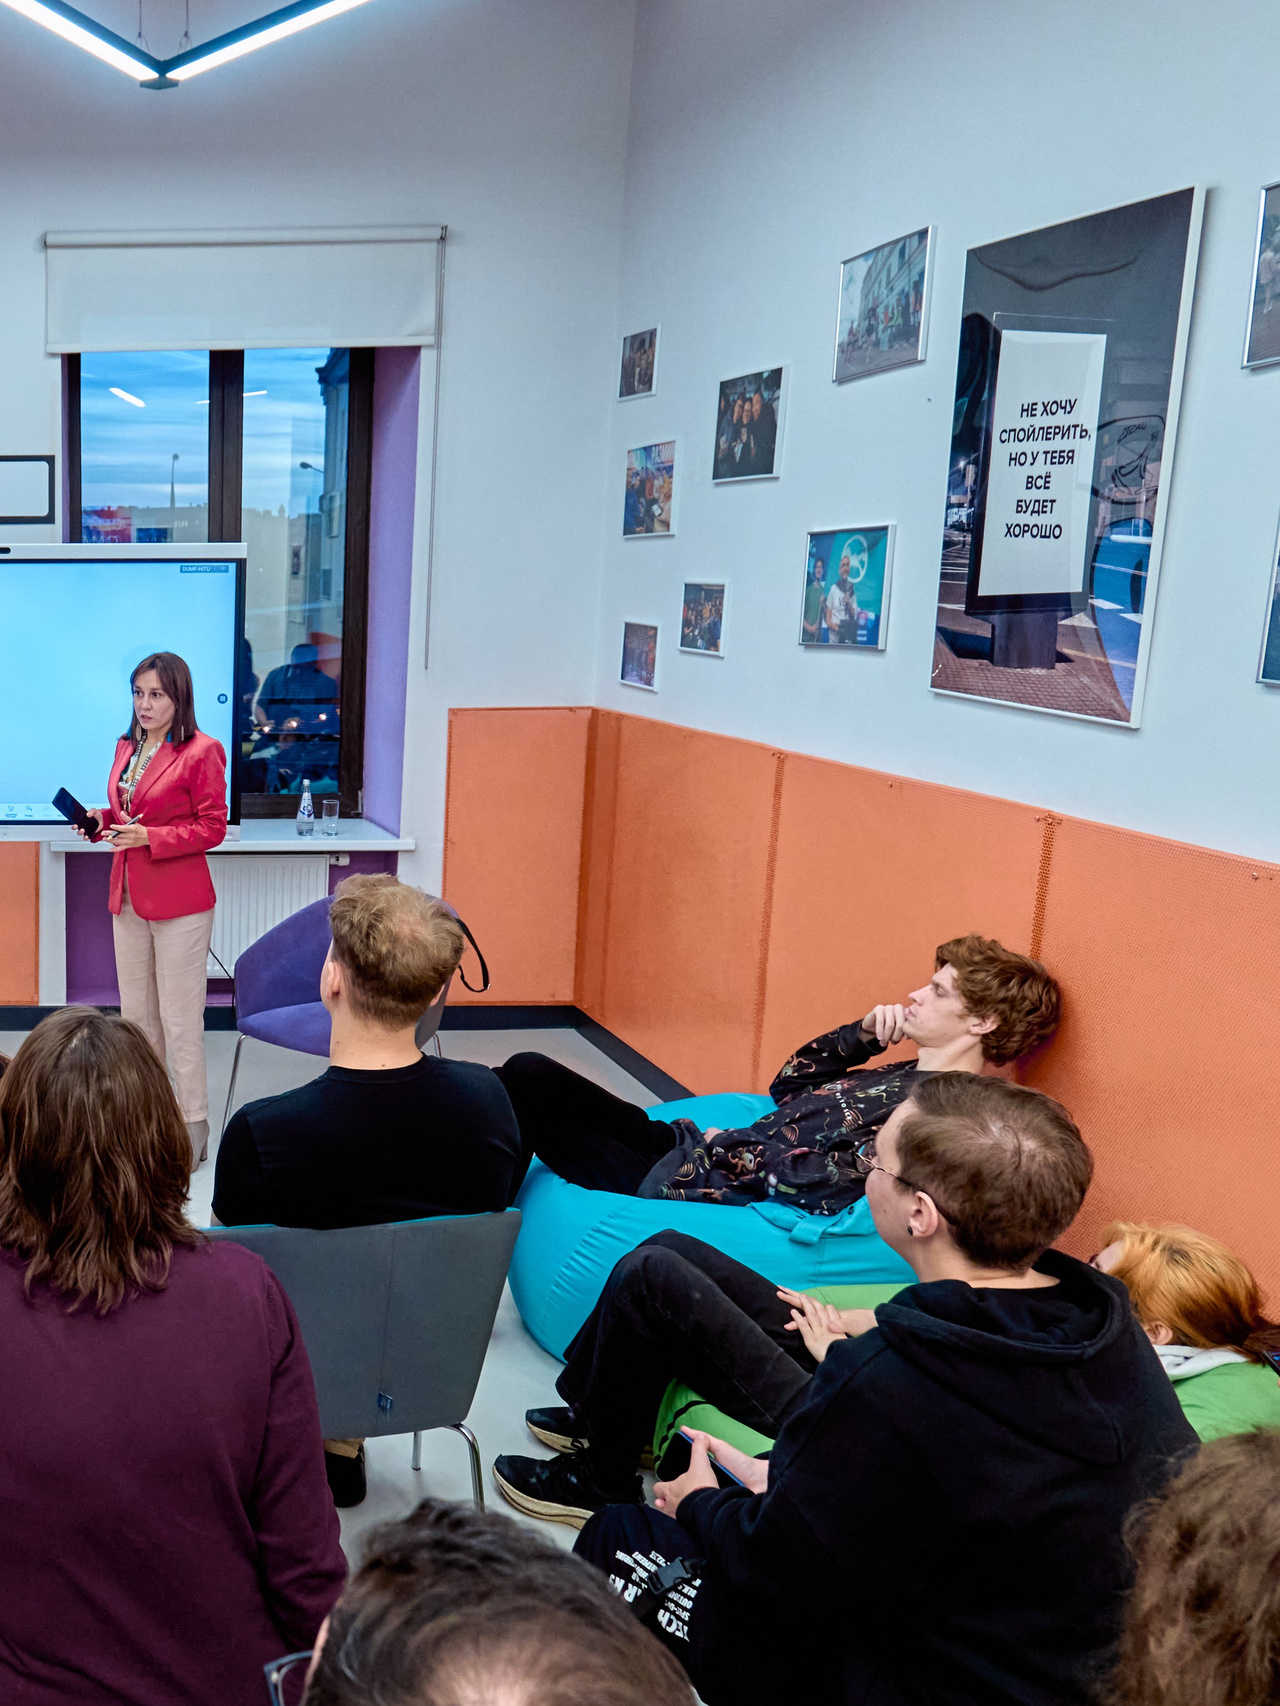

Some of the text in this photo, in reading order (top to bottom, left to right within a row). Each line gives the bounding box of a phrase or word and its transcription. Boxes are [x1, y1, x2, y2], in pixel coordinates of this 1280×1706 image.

[1020, 398, 1078, 418] НЕ ХОЧУ
[999, 423, 1091, 444] СПОЙЛЕРИТЬ,
[1008, 449, 1075, 467] НО У ТЕБЯ
[1025, 472, 1051, 490] ВСЁ
[1015, 499, 1057, 517] БУДЕТ
[1004, 523, 1063, 539] ХОРОШО
